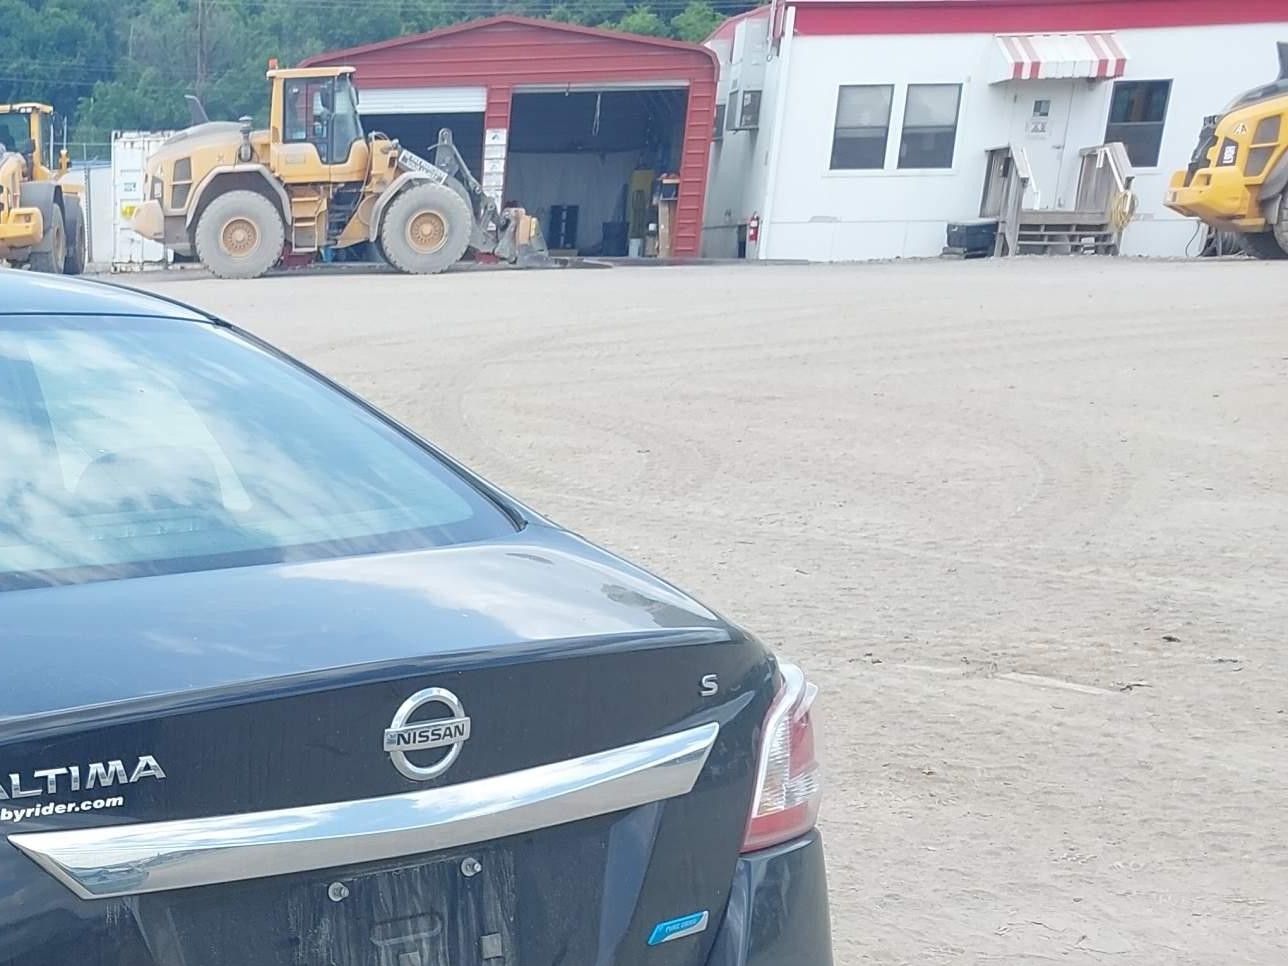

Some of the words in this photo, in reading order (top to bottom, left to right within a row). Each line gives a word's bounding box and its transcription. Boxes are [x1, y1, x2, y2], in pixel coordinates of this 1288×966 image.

[701, 674, 719, 697] S
[396, 723, 465, 746] NISSAN
[0, 796, 124, 822] byrider.com
